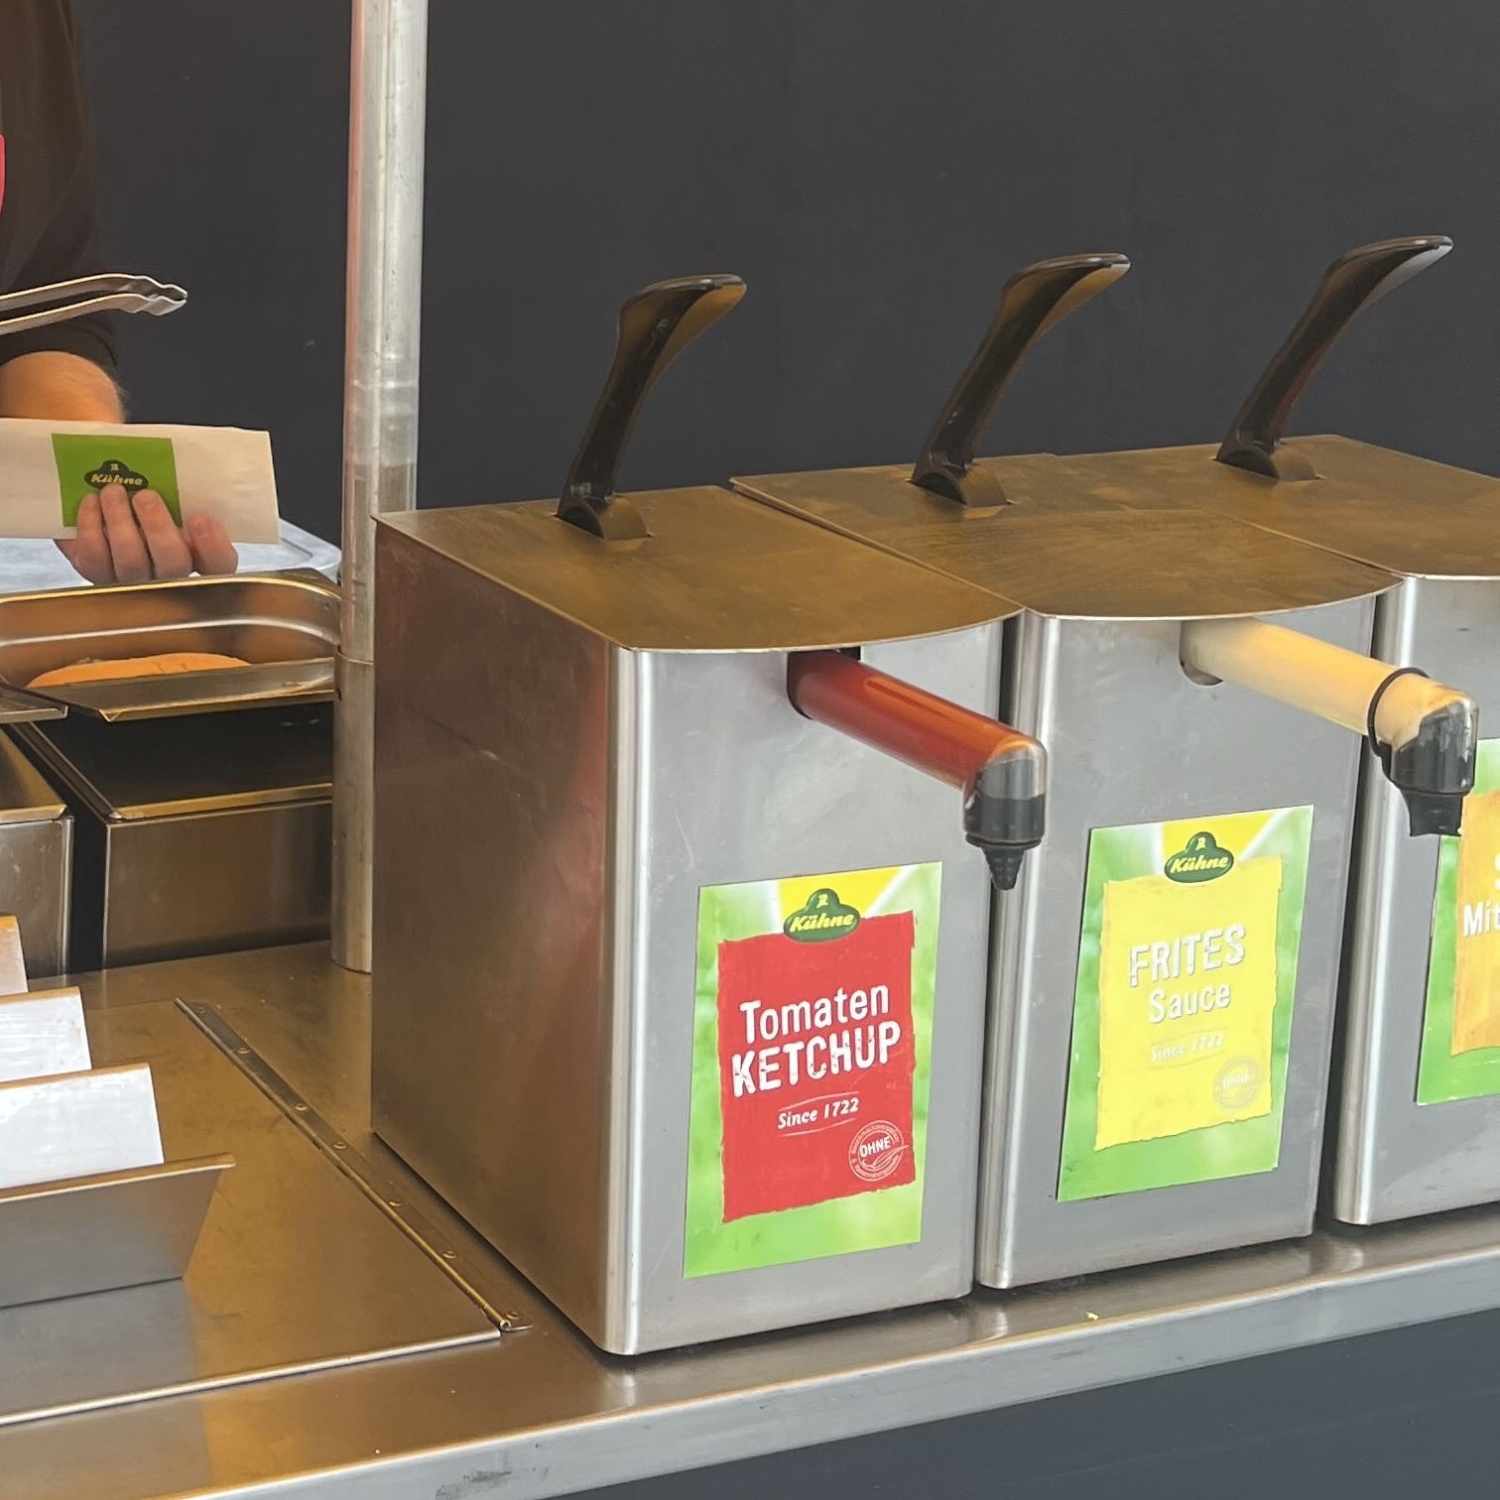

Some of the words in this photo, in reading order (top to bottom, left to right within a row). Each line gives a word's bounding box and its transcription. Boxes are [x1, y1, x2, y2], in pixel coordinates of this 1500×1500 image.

[1169, 853, 1231, 874] Kühne
[789, 912, 854, 932] Kühne
[1128, 923, 1246, 988] FRITES
[739, 984, 889, 1045] Tomaten
[1148, 982, 1232, 1024] Sauce
[731, 1020, 901, 1098] KETCHUP
[777, 1108, 818, 1131] Since
[822, 1097, 860, 1121] 1722
[859, 1135, 891, 1158] OHNE
